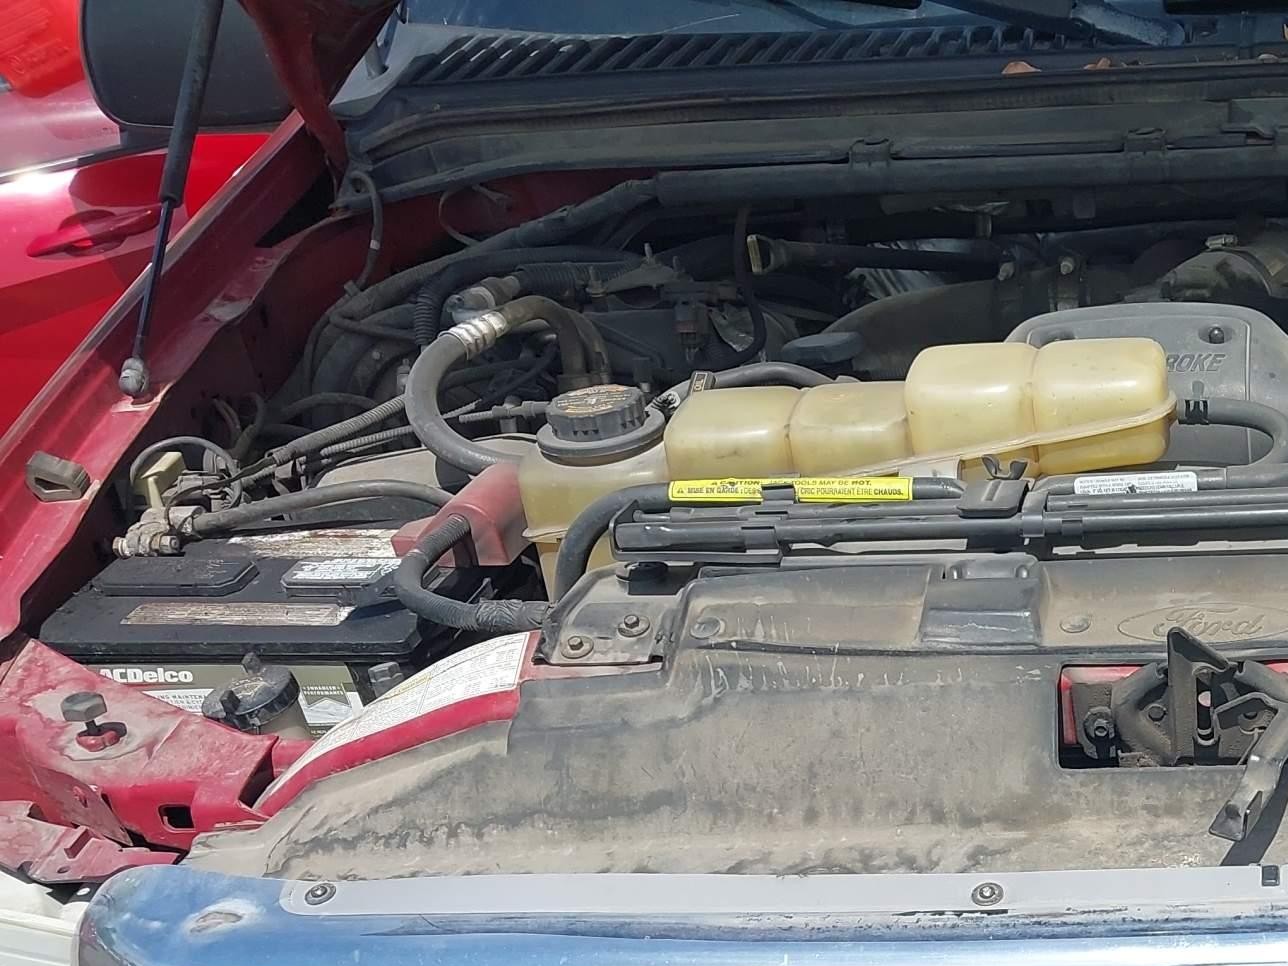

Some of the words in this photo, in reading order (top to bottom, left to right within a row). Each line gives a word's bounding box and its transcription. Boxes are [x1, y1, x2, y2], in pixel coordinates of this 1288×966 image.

[1166, 353, 1226, 372] ROKE
[874, 487, 904, 495] CHAUDS.
[1153, 607, 1265, 637] Ford
